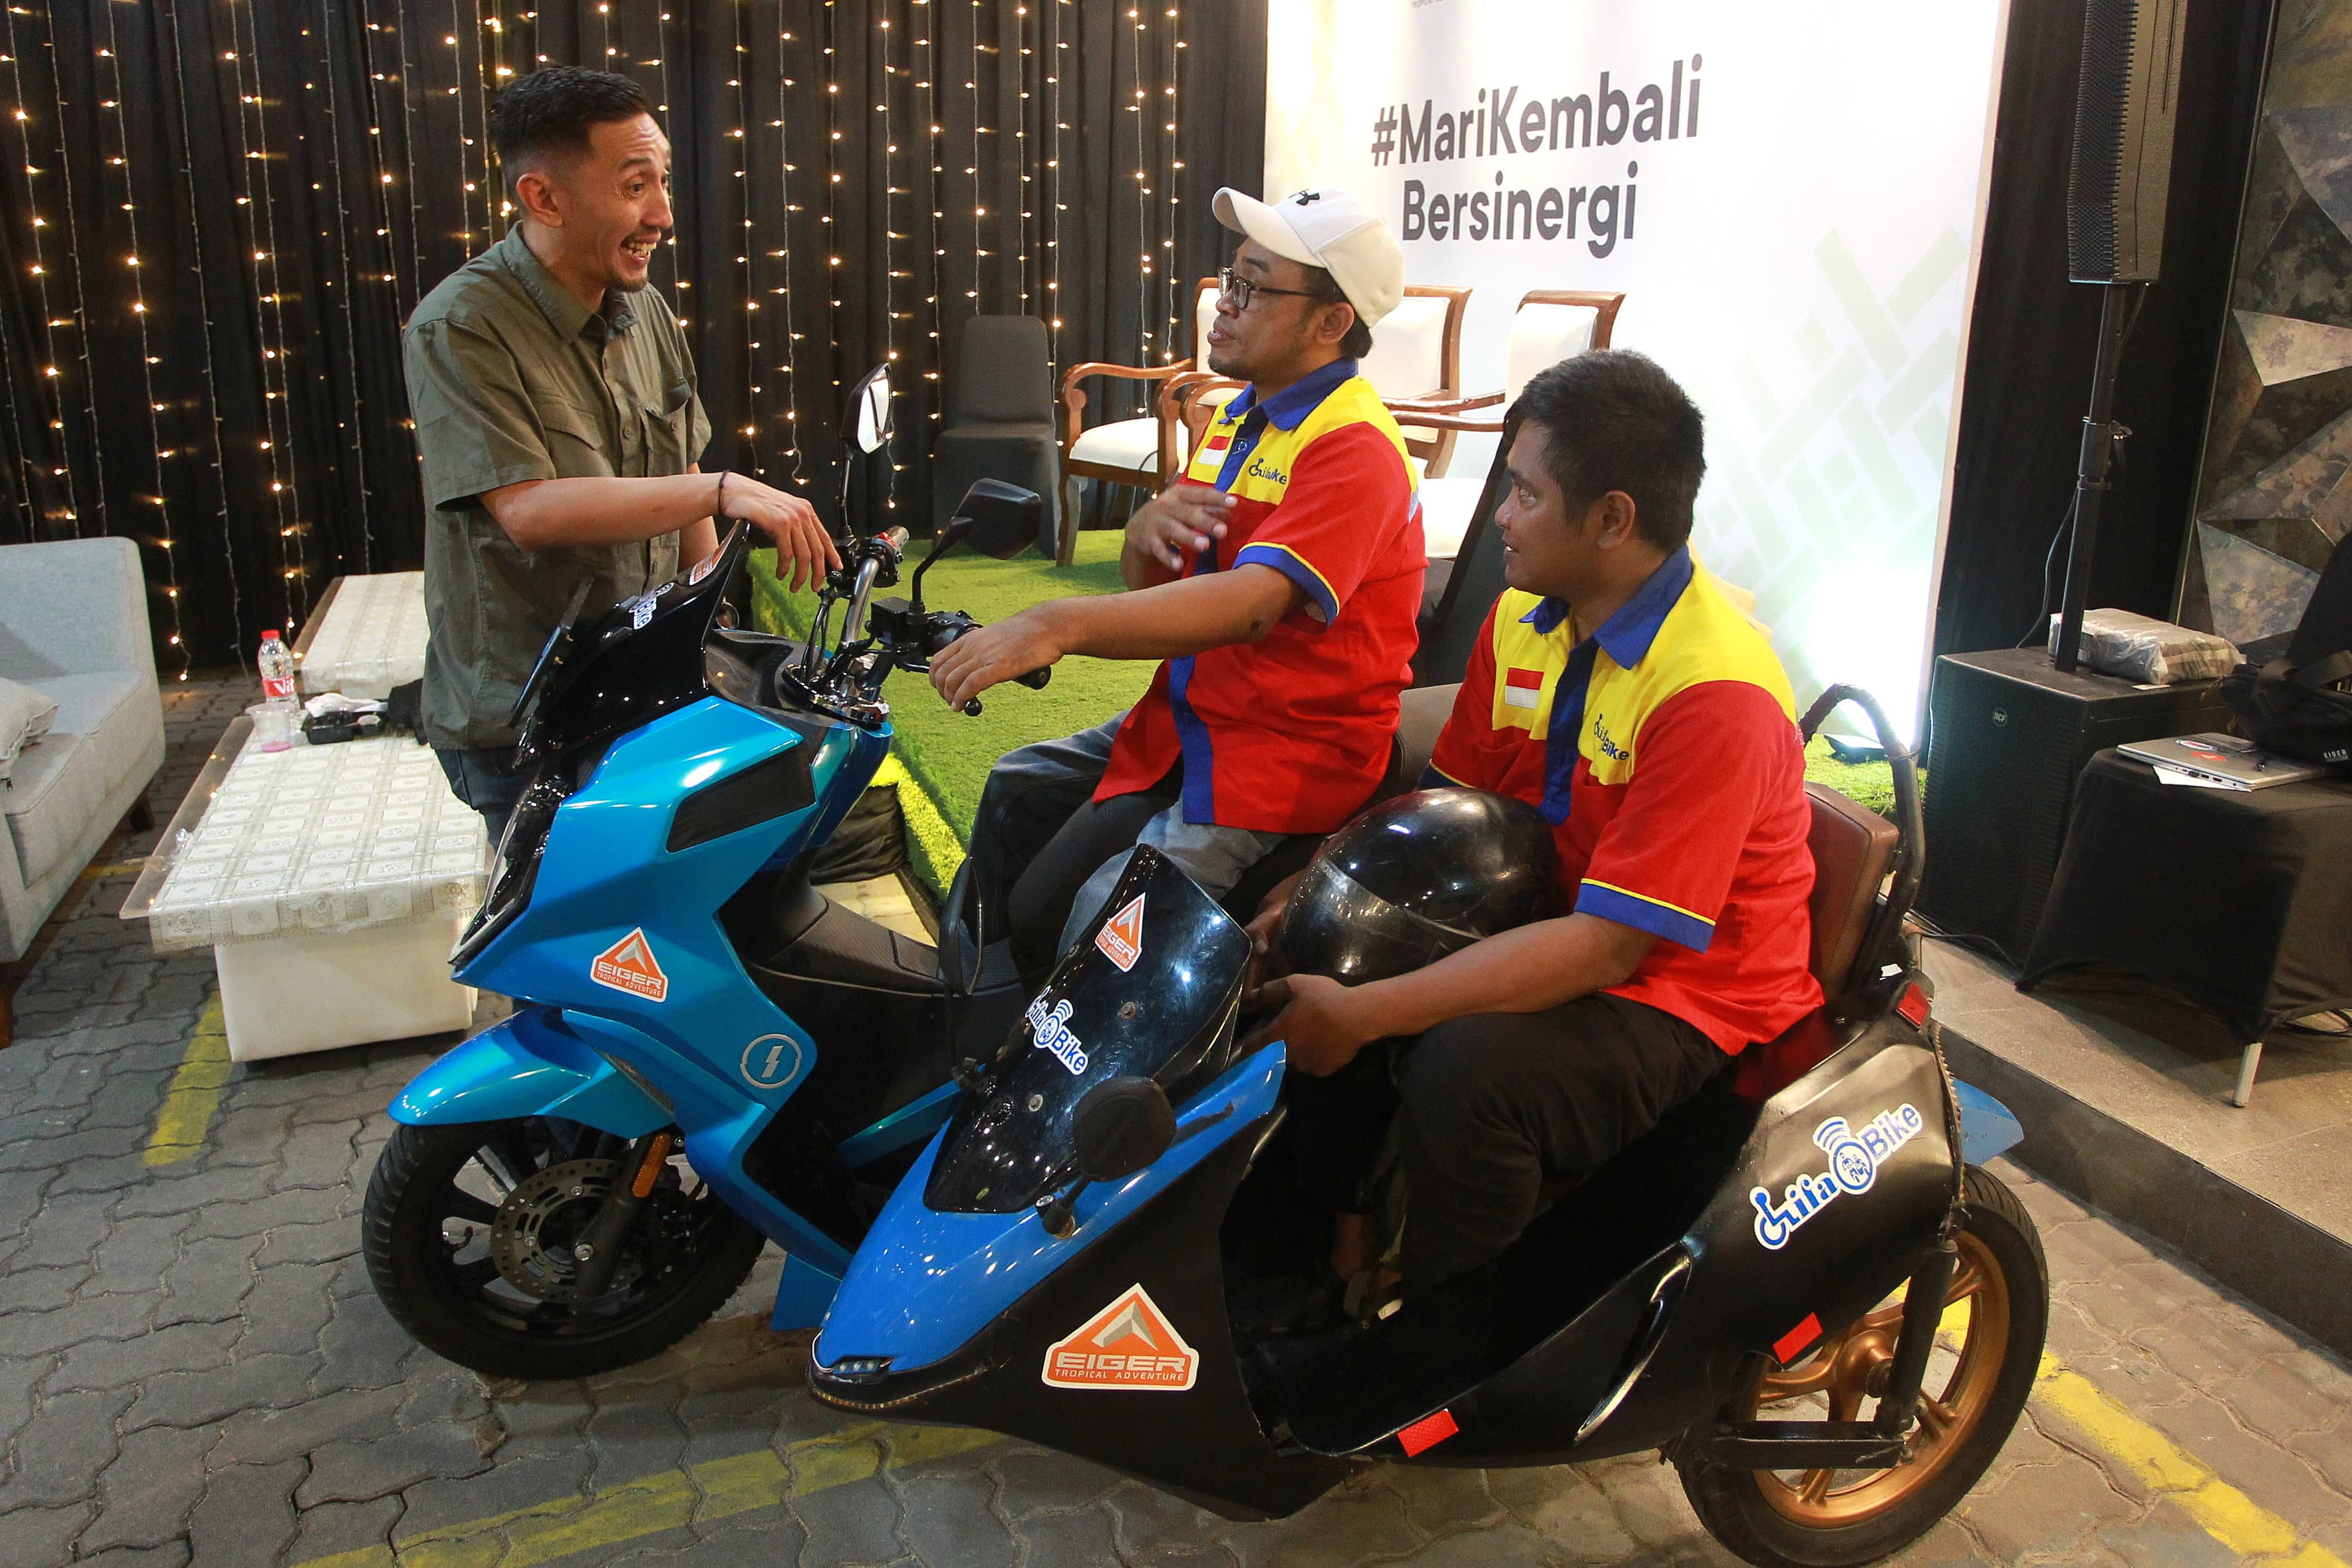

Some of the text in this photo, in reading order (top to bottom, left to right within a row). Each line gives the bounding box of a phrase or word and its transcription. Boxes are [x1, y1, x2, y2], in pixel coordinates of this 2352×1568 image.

[1371, 53, 1703, 167] #MariKembali
[1402, 160, 1638, 258] Bersinergi
[2323, 749, 2348, 759] EIGER
[1101, 924, 1137, 960] EIGER
[596, 971, 661, 997] TROPICAL ADVENTURE
[597, 961, 663, 989] EIGER
[1051, 1029, 1086, 1071] Bike
[1861, 1106, 1919, 1160] Bike
[1054, 1368, 1185, 1381] TROPICAL ADVENTURE
[1056, 1351, 1186, 1372] EIGER
